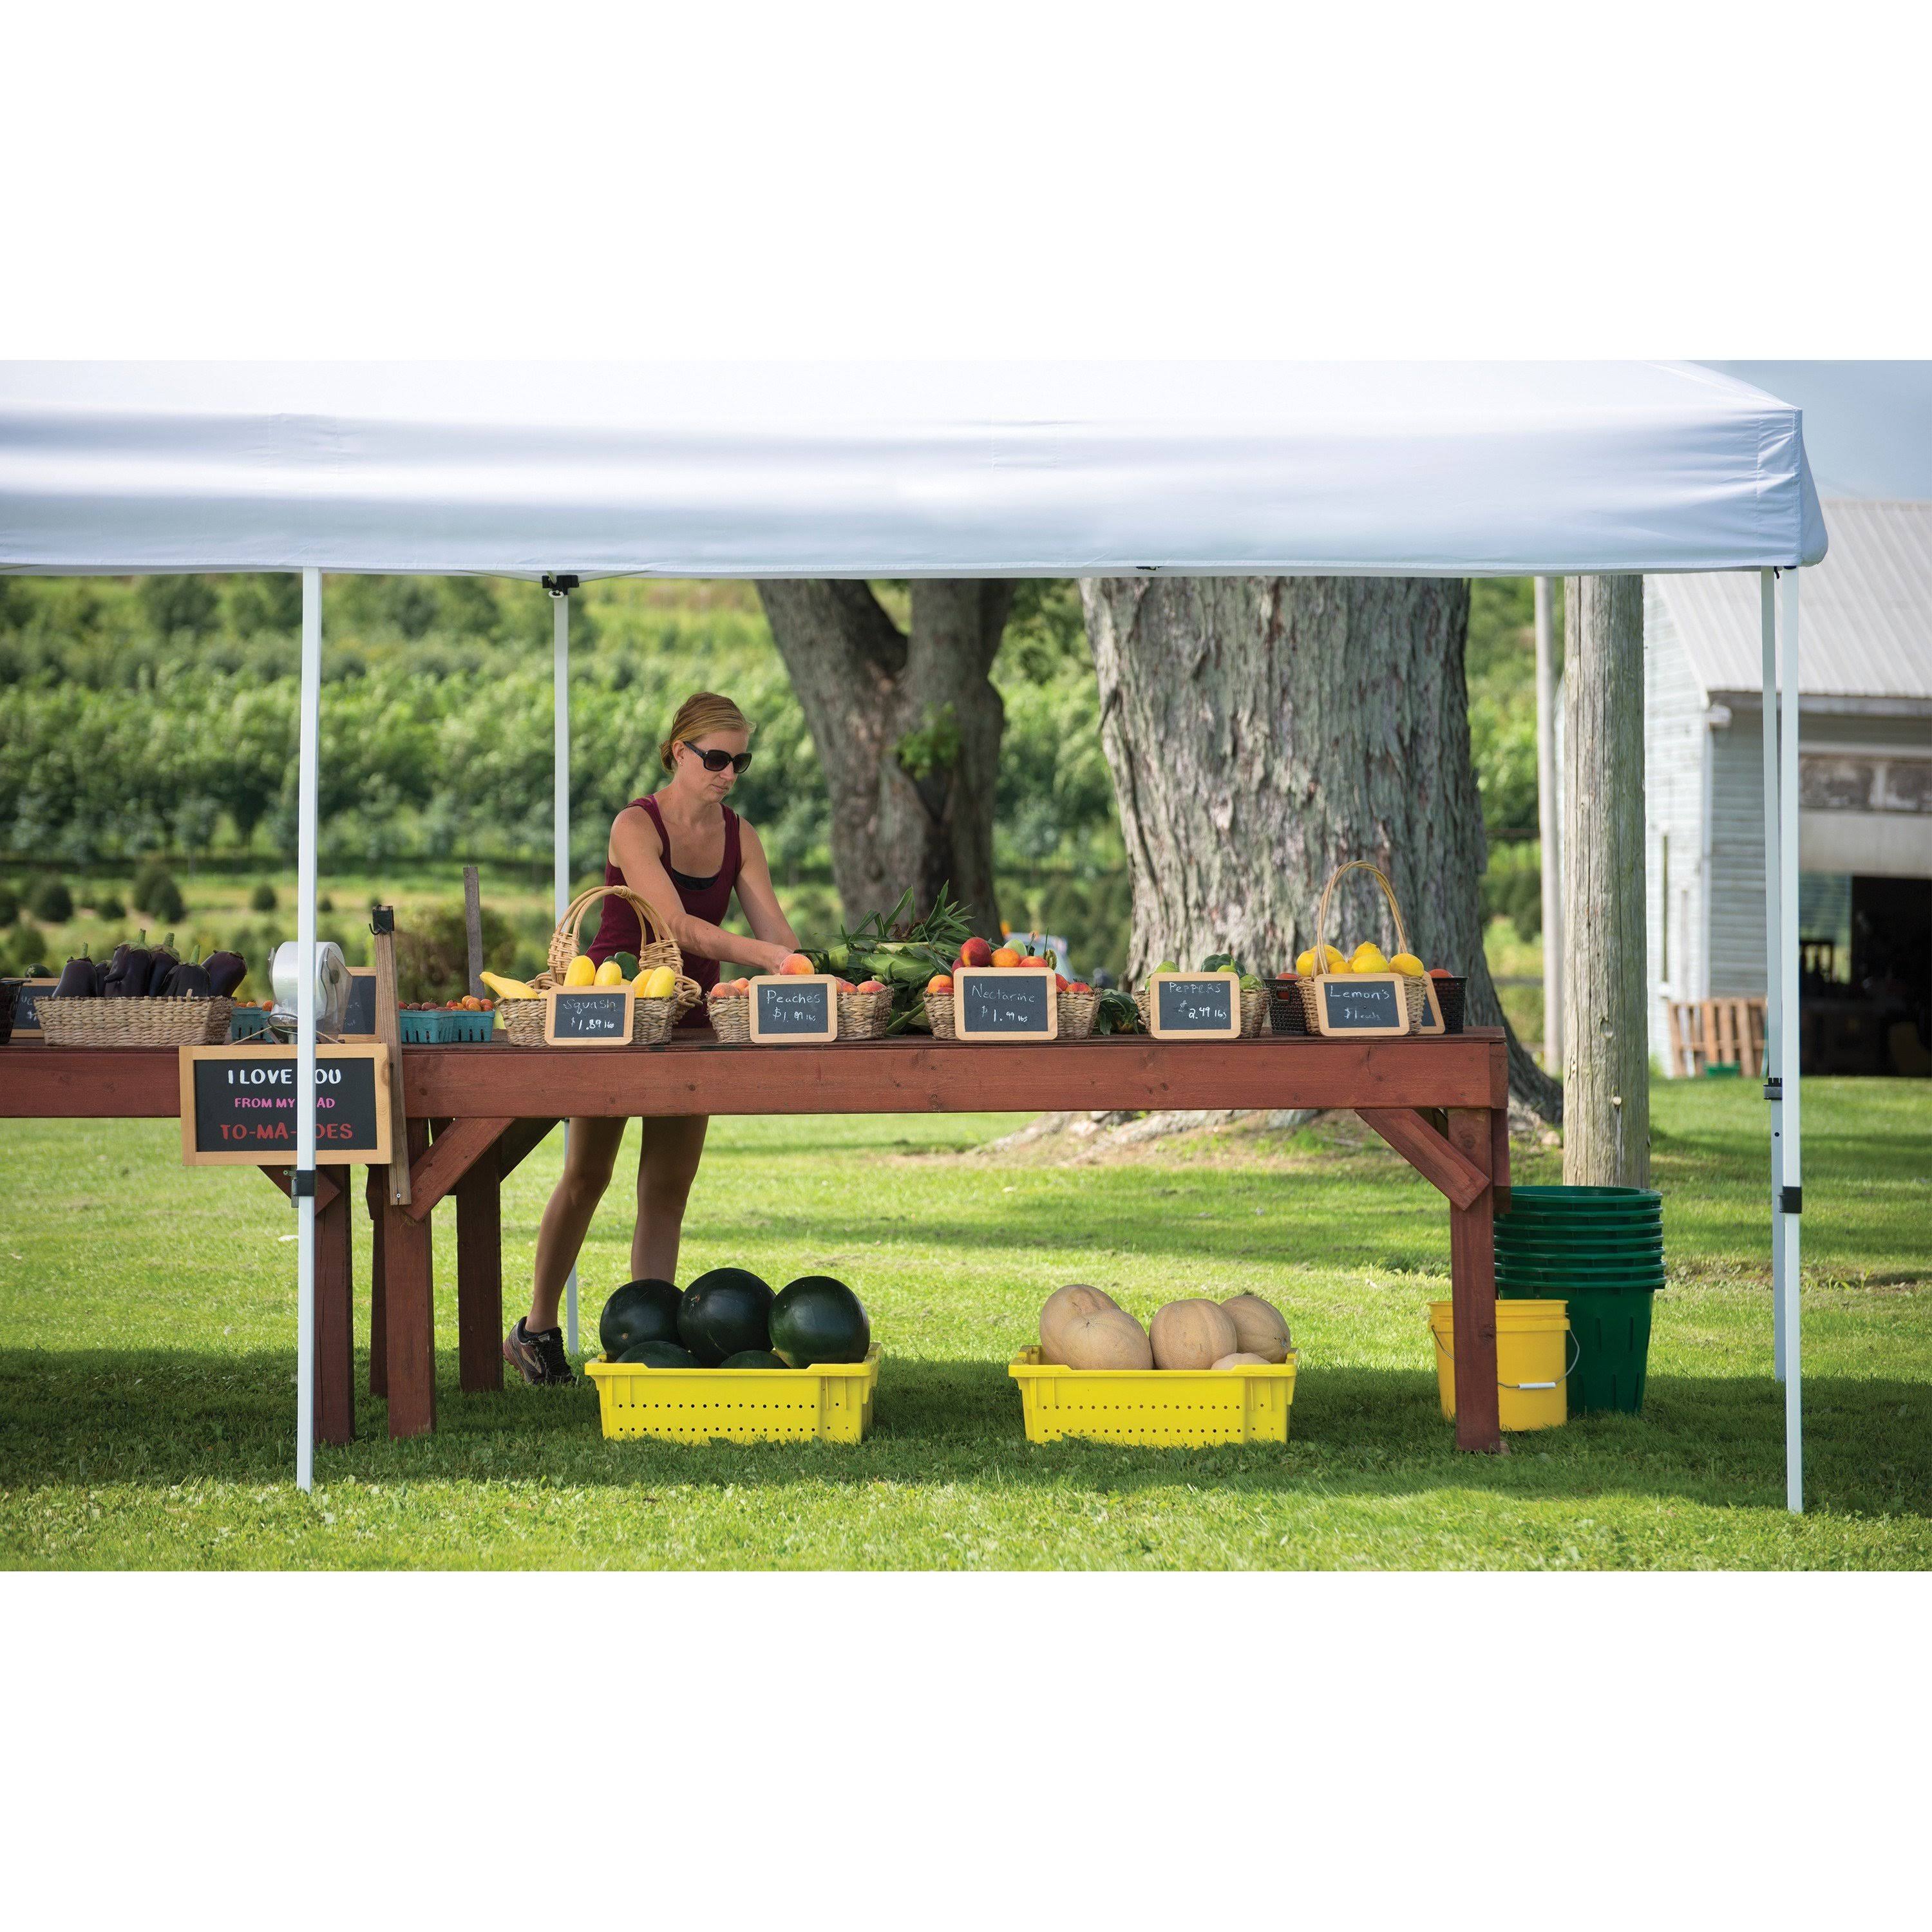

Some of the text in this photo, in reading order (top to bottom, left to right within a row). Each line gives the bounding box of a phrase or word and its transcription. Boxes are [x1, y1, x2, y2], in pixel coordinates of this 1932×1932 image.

[766, 990, 820, 1004] Peaches
[971, 983, 1035, 1003] Nectarine
[1330, 985, 1390, 1000] Lemon's
[563, 999, 616, 1014] Squash
[228, 1068, 341, 1084] I LOVE OU
[234, 1097, 335, 1108] FROM MY AD
[220, 1122, 354, 1140] TO-MA-OES
